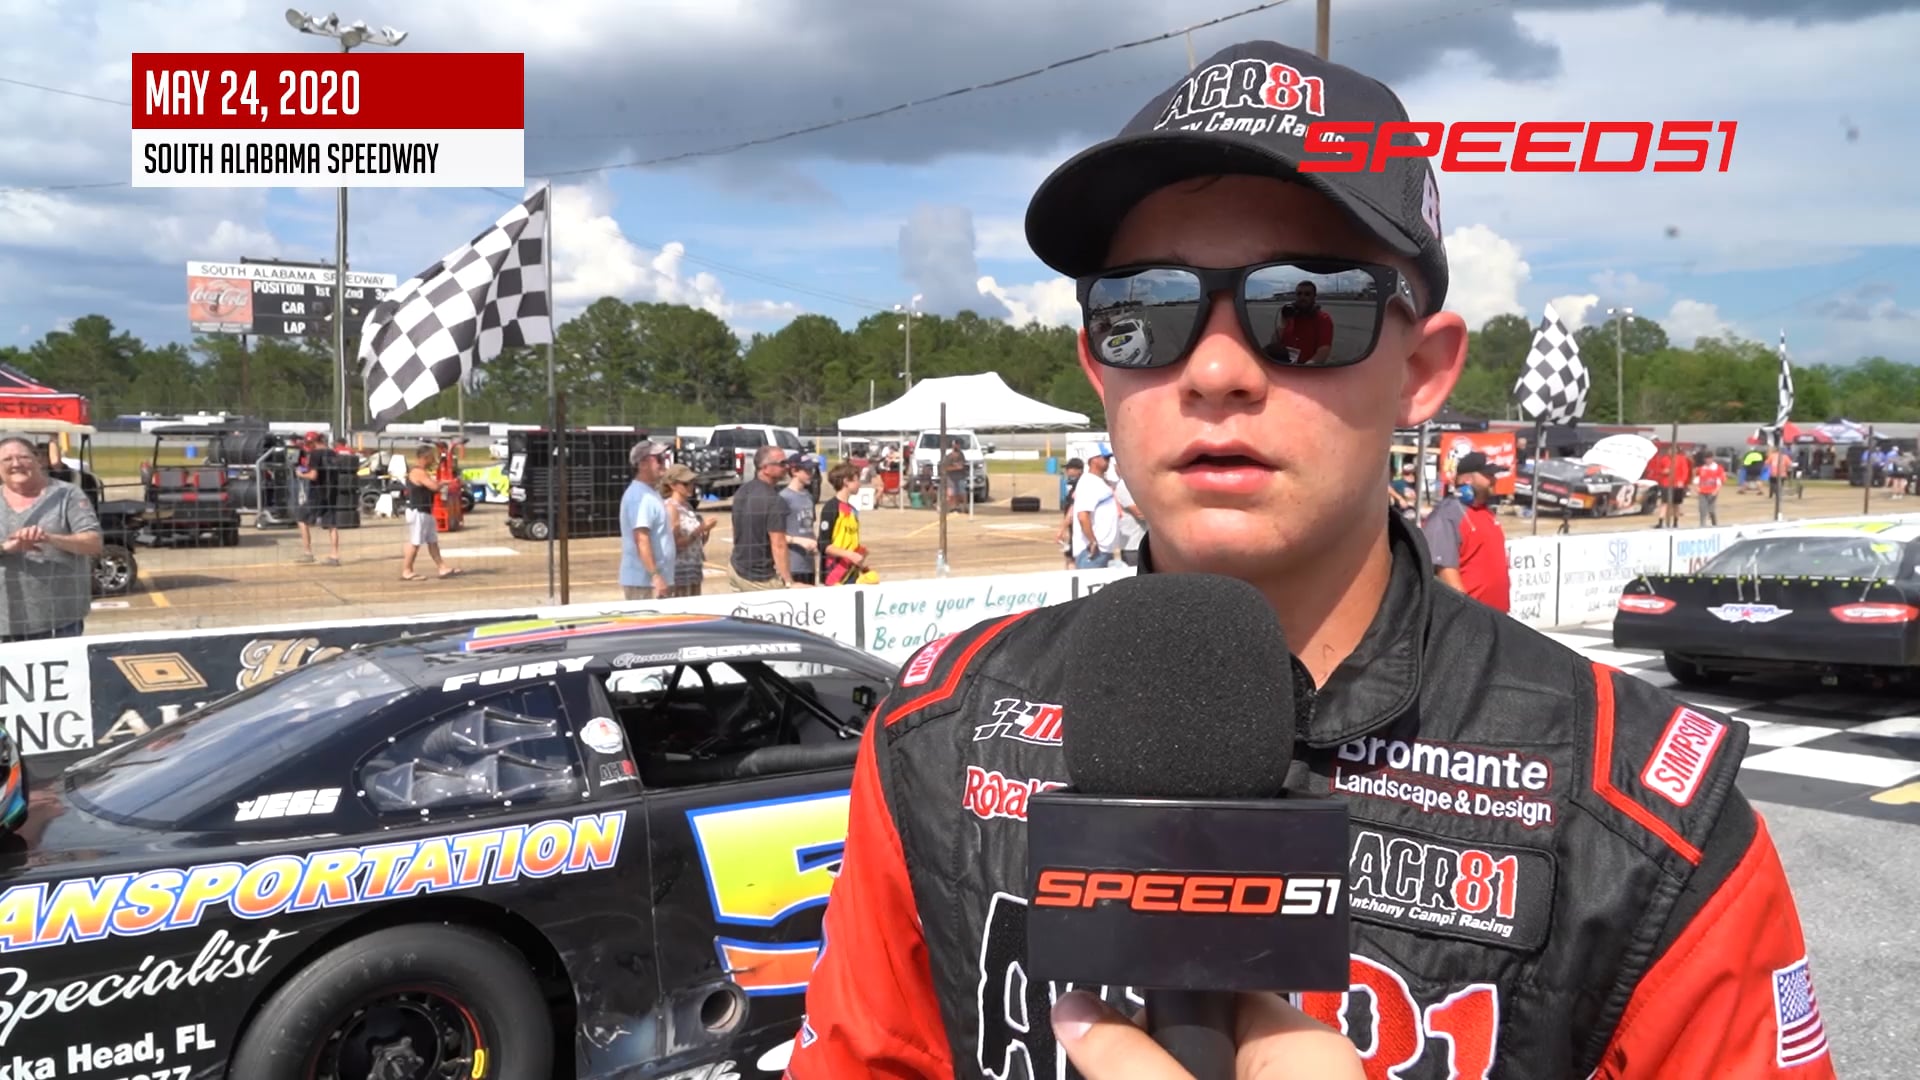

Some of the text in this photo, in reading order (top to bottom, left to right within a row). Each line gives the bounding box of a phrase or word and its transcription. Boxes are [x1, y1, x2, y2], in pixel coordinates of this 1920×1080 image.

[1153, 59, 1325, 131] ACR81
[1205, 112, 1277, 136] Campi
[201, 264, 385, 285] SOUTH ALABAMA SPEDWAY
[254, 282, 305, 296] POSITION
[314, 285, 331, 298] 1st
[281, 302, 305, 314] CAR
[284, 322, 306, 335] LAP
[1616, 485, 1635, 509] 43
[874, 585, 1048, 619] Leave your Legacy
[873, 629, 896, 651] Be
[442, 655, 594, 692] FURY
[0, 709, 88, 750] NG.
[1338, 735, 1548, 790] Bromante
[1653, 710, 1717, 794] SIMPSON
[1335, 766, 1553, 826] Landscape & Design
[1035, 870, 1342, 915] SPEED51
[1350, 831, 1518, 919] ACR81
[1409, 906, 1457, 926] Campi
[1459, 911, 1514, 937] Racing
[0, 929, 299, 1047] Specialist
[67, 1033, 165, 1074] Head,
[176, 1023, 216, 1054] FL
